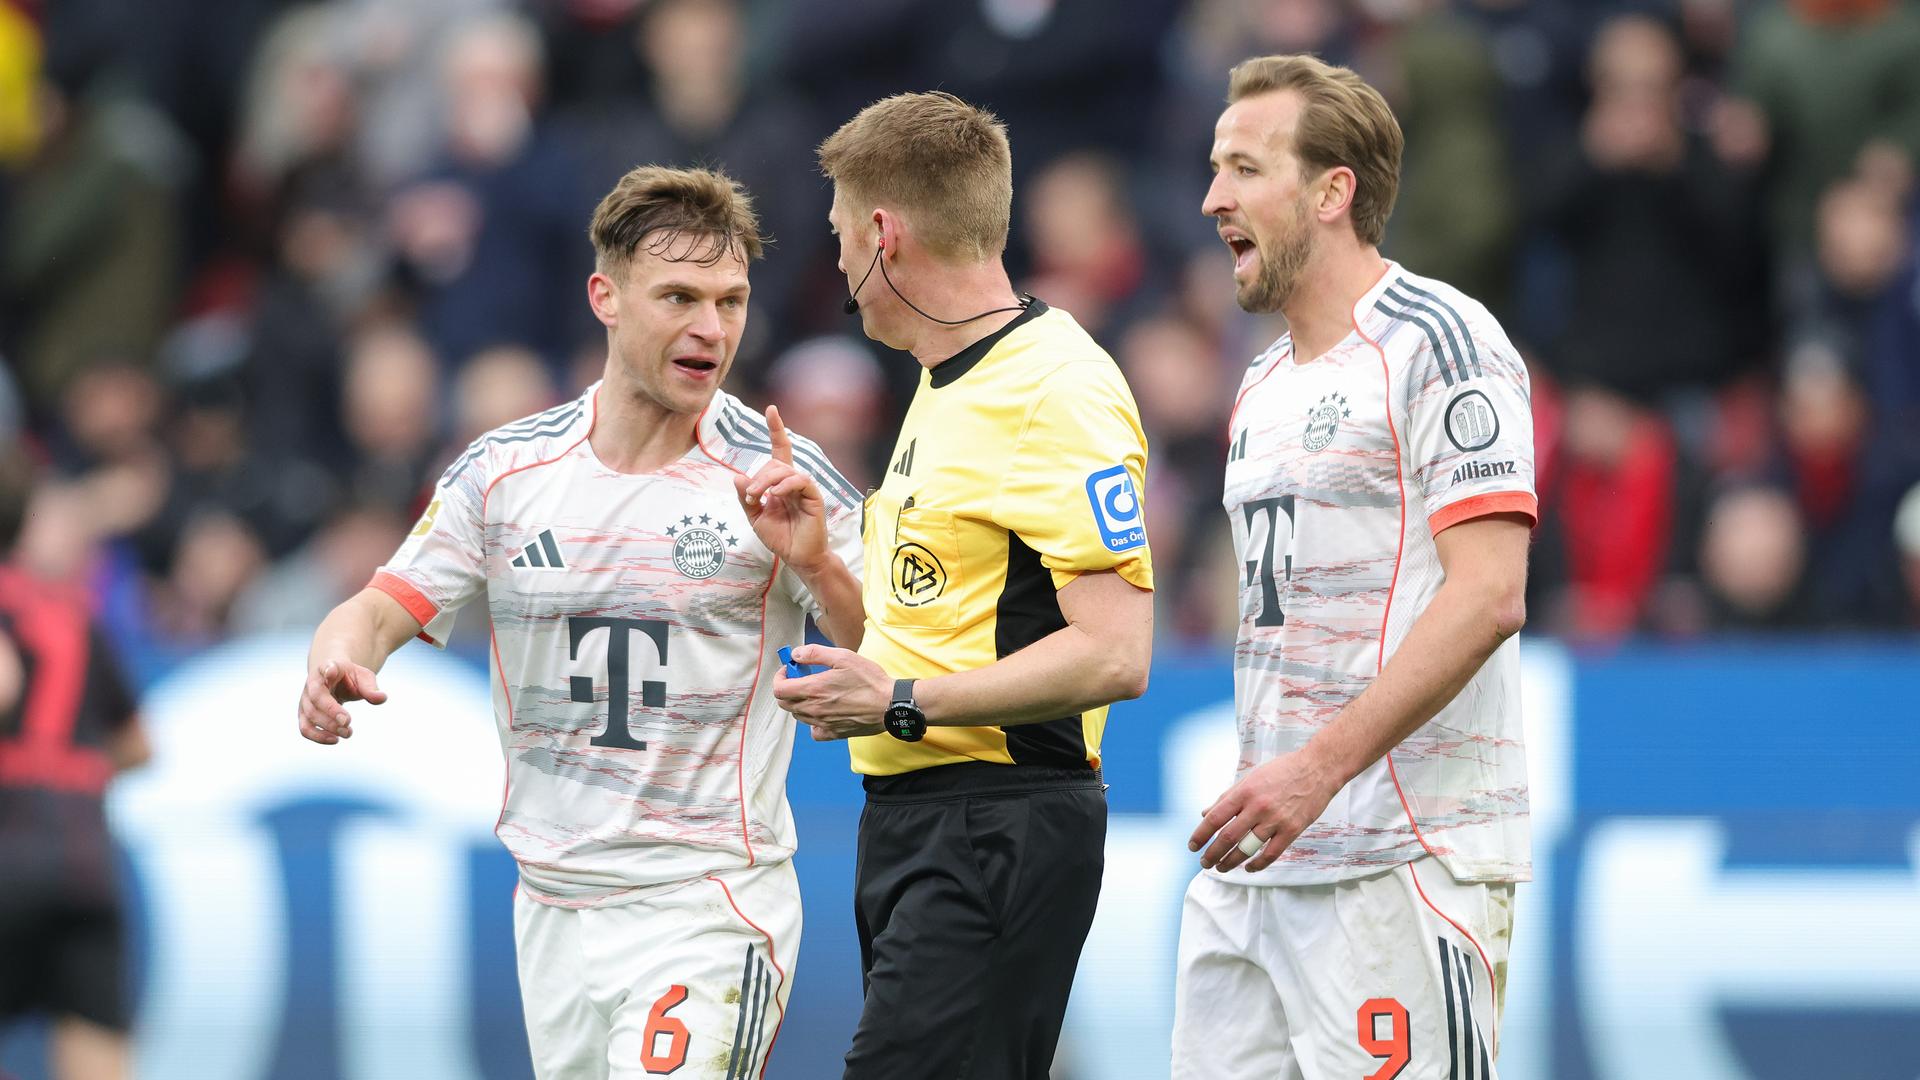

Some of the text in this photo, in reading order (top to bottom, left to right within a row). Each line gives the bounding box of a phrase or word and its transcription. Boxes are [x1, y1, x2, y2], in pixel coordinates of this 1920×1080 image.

[1450, 460, 1517, 487] Allianz
[678, 531, 722, 553] FC BAYERN
[1110, 536, 1128, 547] Das
[1243, 495, 1295, 627] T
[568, 617, 669, 751] T
[640, 984, 691, 1075] 6
[1357, 998, 1412, 1080] 9
